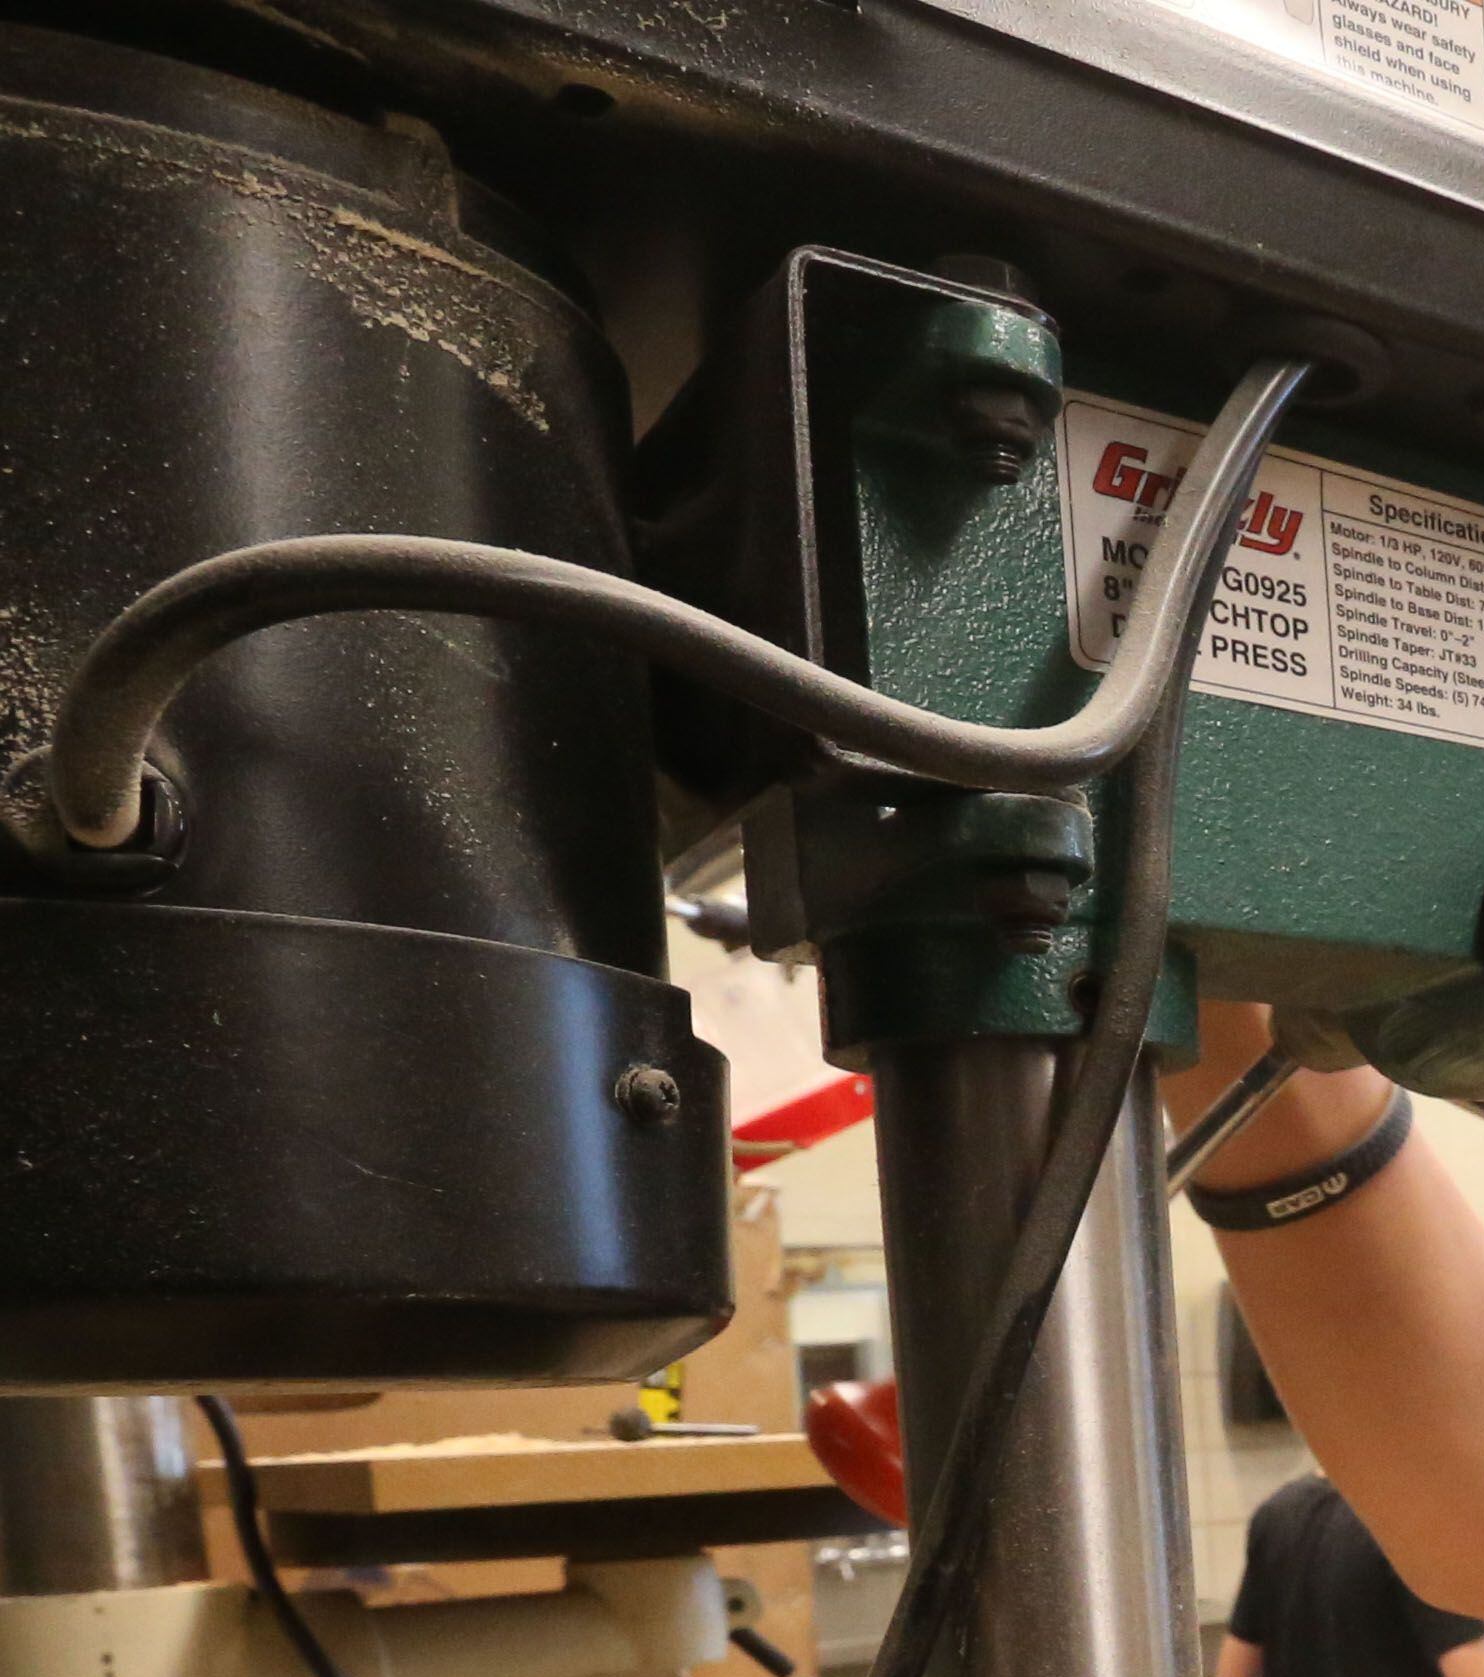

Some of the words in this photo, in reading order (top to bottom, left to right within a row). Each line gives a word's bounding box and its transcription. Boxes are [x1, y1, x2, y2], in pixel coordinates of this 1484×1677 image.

[1331, 0, 1387, 24] lways
[1391, 16, 1428, 41] wear
[1431, 34, 1476, 64] safety
[1332, 14, 1392, 47] glasses
[1396, 40, 1424, 60] and
[1429, 51, 1460, 75] face
[1334, 35, 1381, 63] shield
[1385, 56, 1426, 81] when
[1431, 74, 1472, 104] using
[1337, 54, 1366, 76] this
[1370, 69, 1439, 107] machine.
[1330, 521, 1375, 544] Motor:
[1379, 535, 1400, 551] 1/3
[1430, 548, 1465, 570] 120V,
[1331, 542, 1384, 567] Spindle
[1388, 555, 1401, 571] to
[1405, 561, 1456, 586] Column
[1103, 575, 1133, 601] 8"
[1222, 565, 1308, 608] G0925
[1333, 563, 1385, 587] Spindle
[1389, 576, 1402, 592] to
[1406, 580, 1442, 601] Table
[1445, 591, 1475, 610] Dist:
[1334, 583, 1387, 608] Spindle
[1390, 596, 1404, 612] to
[1408, 601, 1440, 621] Base
[1444, 610, 1473, 629] Dist:
[1336, 603, 1388, 629] Spindle
[1392, 617, 1436, 640] Travel:
[1211, 634, 1308, 677] PRESS
[1337, 624, 1389, 649] Spindle
[1393, 638, 1435, 660] Taper:
[1439, 651, 1477, 668] JT#33
[1339, 646, 1388, 670] Drilling
[1392, 658, 1449, 684] Capacity
[1340, 666, 1392, 690] Spindle
[1395, 678, 1448, 701] Speeds:
[1452, 691, 1470, 708] (5)
[1341, 686, 1394, 710] Weight:
[1397, 698, 1412, 713] 34
[1416, 702, 1440, 718] lbs.
